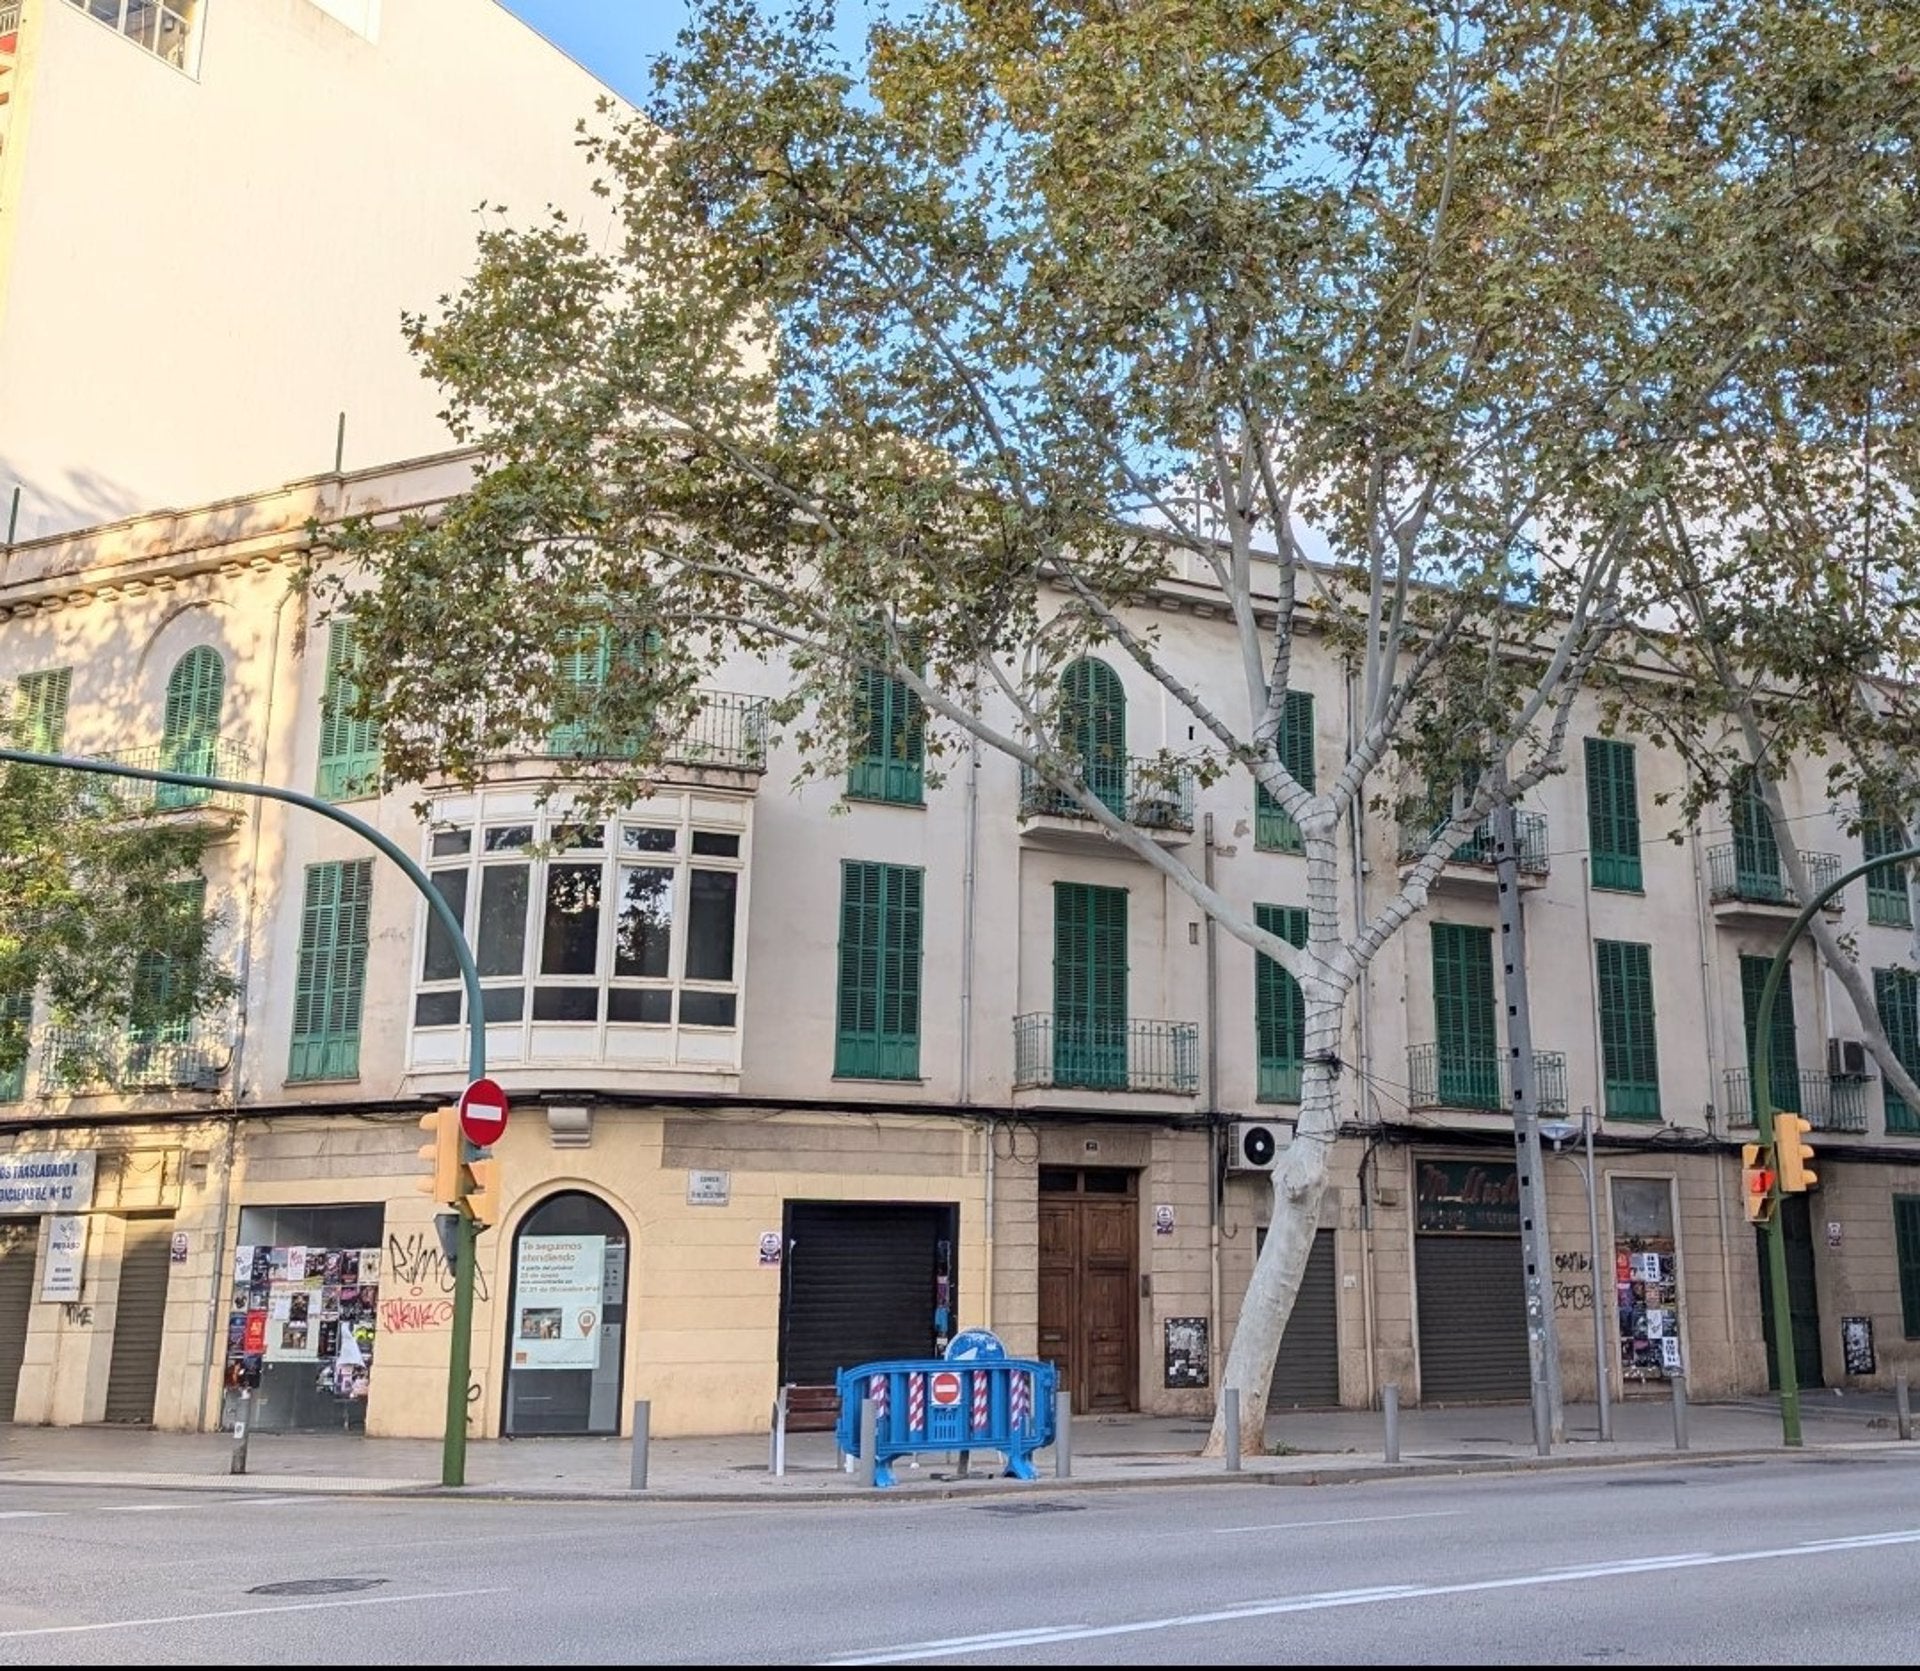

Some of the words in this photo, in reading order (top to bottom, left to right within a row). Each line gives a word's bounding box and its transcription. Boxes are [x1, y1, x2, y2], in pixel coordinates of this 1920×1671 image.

[13, 1163, 70, 1179] TRASLADADO
[71, 1162, 77, 1177] A
[535, 1243, 582, 1252] seguimos
